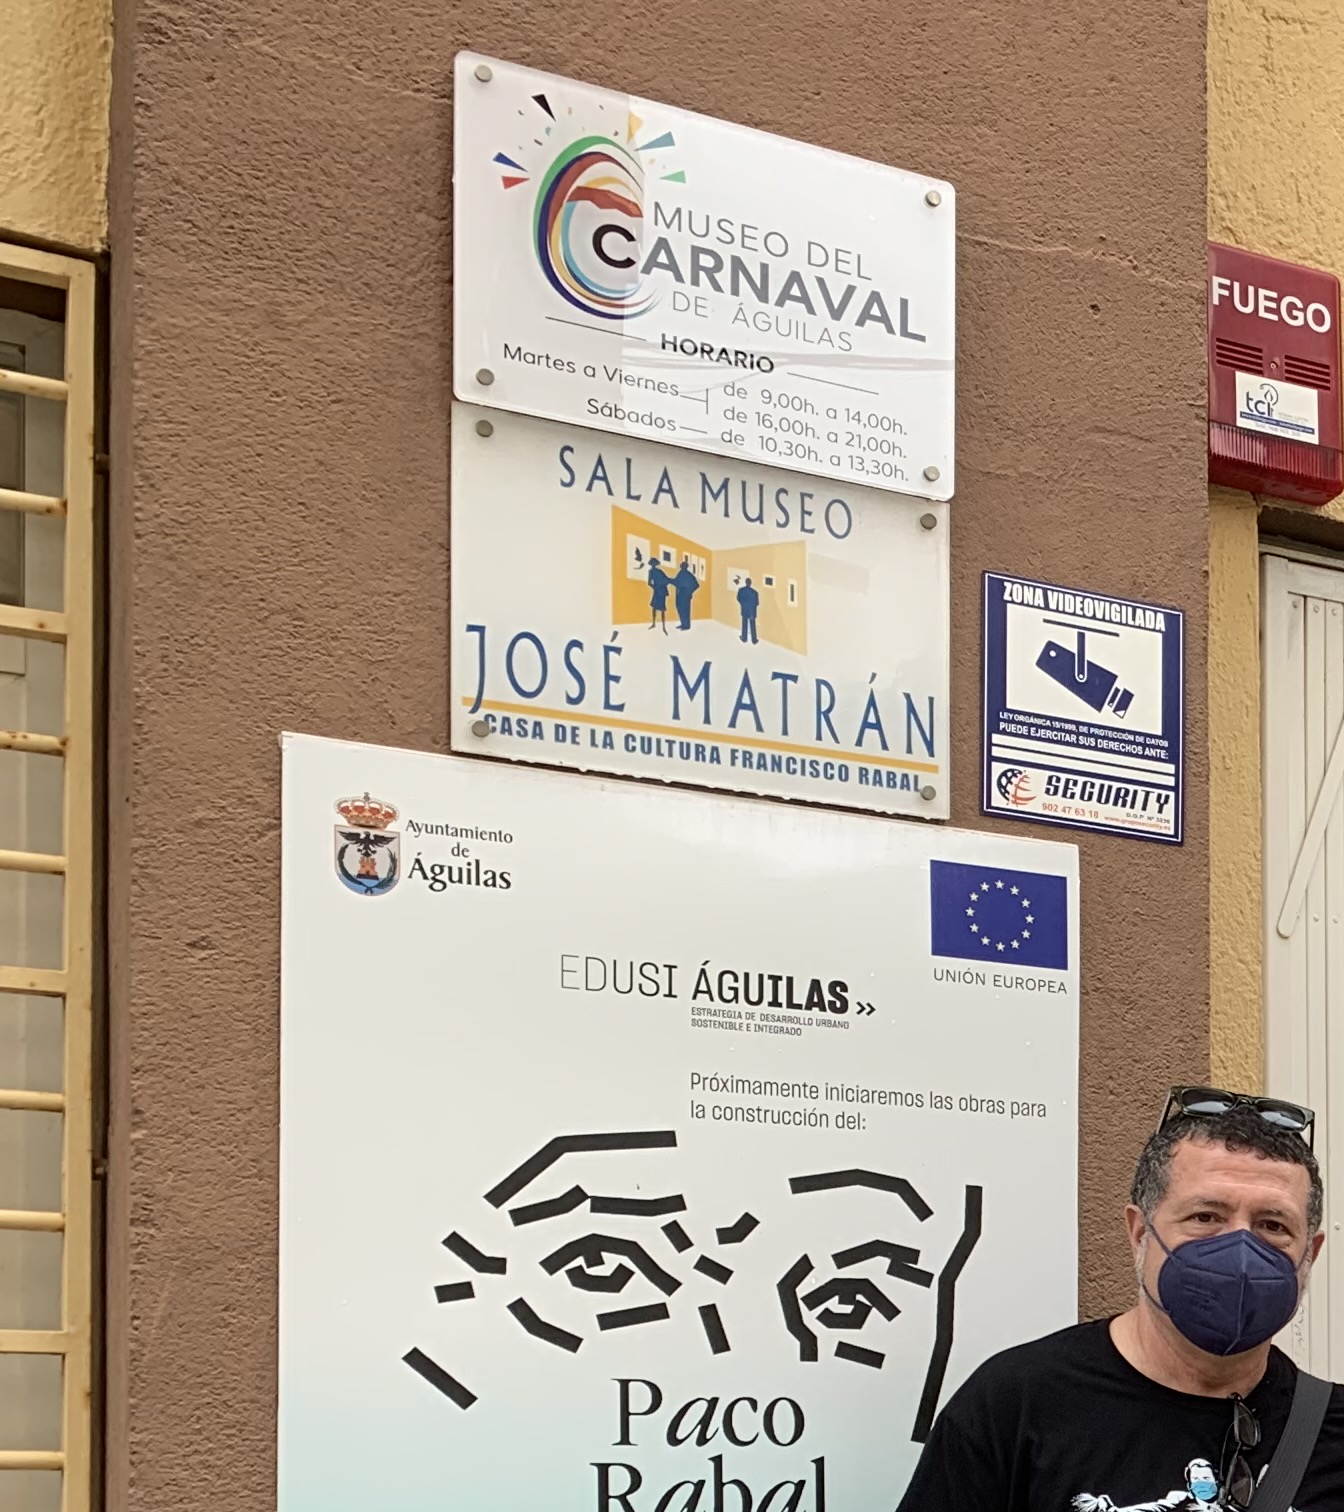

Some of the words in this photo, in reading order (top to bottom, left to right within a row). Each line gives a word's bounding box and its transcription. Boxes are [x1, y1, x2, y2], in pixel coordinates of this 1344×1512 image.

[653, 201, 789, 258] MUSEO
[807, 241, 873, 281] DEL
[592, 223, 927, 343] CARNAVAL
[1212, 276, 1332, 335] FUEGO
[673, 292, 709, 319] DE
[731, 302, 854, 353] ÁGUILAS
[503, 343, 576, 375] Martes
[584, 363, 596, 379] a
[603, 365, 680, 398] Viernes
[661, 333, 775, 375] HORARIO
[587, 398, 678, 433] Sábados
[723, 381, 748, 401] de
[761, 389, 820, 417] 9,00h.
[826, 405, 838, 420] a
[844, 408, 908, 437] 14,00h.
[723, 405, 748, 425] de
[755, 411, 821, 441] 16,00h.
[826, 428, 839, 444] a
[845, 431, 907, 460] 21,00h.
[720, 427, 745, 447] de
[758, 435, 824, 466] 10,30h.
[829, 452, 842, 468] a
[848, 455, 910, 483] 13,30h.
[560, 445, 680, 509] SALA
[700, 472, 853, 540] MUSEO
[1003, 581, 1044, 608] ZONA
[1047, 589, 1166, 632] VIDEOVIGILADA
[465, 624, 626, 715] JOSÉ
[670, 655, 936, 758] MATRÁN
[484, 713, 545, 741] CASA
[554, 723, 581, 746] DE
[590, 728, 615, 751] LA
[624, 733, 722, 766] CULTURA
[730, 748, 850, 784] FRANCISCO
[858, 766, 922, 793] RABAL
[999, 711, 1013, 720] LEY
[1013, 713, 1051, 727] ORGÁNICA
[1079, 725, 1089, 733] DE
[1090, 726, 1134, 741] PROTECCIÓN
[1135, 735, 1145, 743] DE
[1145, 737, 1168, 748] DATOS
[999, 721, 1028, 735] PUEDE
[1030, 727, 1077, 743] EJERCITAR
[1078, 735, 1096, 747] SUS
[1097, 739, 1143, 755] DERECHOS
[1144, 747, 1169, 760] ANTE:
[1042, 803, 1058, 813] 902
[1061, 806, 1072, 815] 47
[1074, 808, 1086, 817] 63
[1088, 810, 1099, 819] 18
[1044, 774, 1170, 814] SECURITY
[406, 819, 514, 845] Ayuntamiento
[451, 841, 470, 859] de
[408, 851, 512, 893] Águilas
[559, 953, 679, 1001] EDUSI
[933, 966, 987, 986] UNIÓN
[993, 973, 1068, 995] EUROPEA
[691, 1007, 742, 1020] ESTRATEGIA
[745, 1012, 756, 1021] DE
[760, 1013, 813, 1026] DESARROLLO
[815, 1019, 849, 1030] URBANO
[691, 1018, 743, 1031] SOSTENIBLE
[746, 1024, 751, 1032] E
[754, 1024, 802, 1036] INTEGRADO
[690, 1072, 820, 1103] Próximamente
[824, 1081, 925, 1110] iniciaremos
[929, 1088, 955, 1111] las
[958, 1091, 1007, 1115] obras
[1010, 1099, 1047, 1120] para
[690, 1099, 708, 1119] la
[711, 1101, 832, 1128] construcción
[835, 1107, 867, 1131] del:
[611, 1377, 807, 1448] Paco
